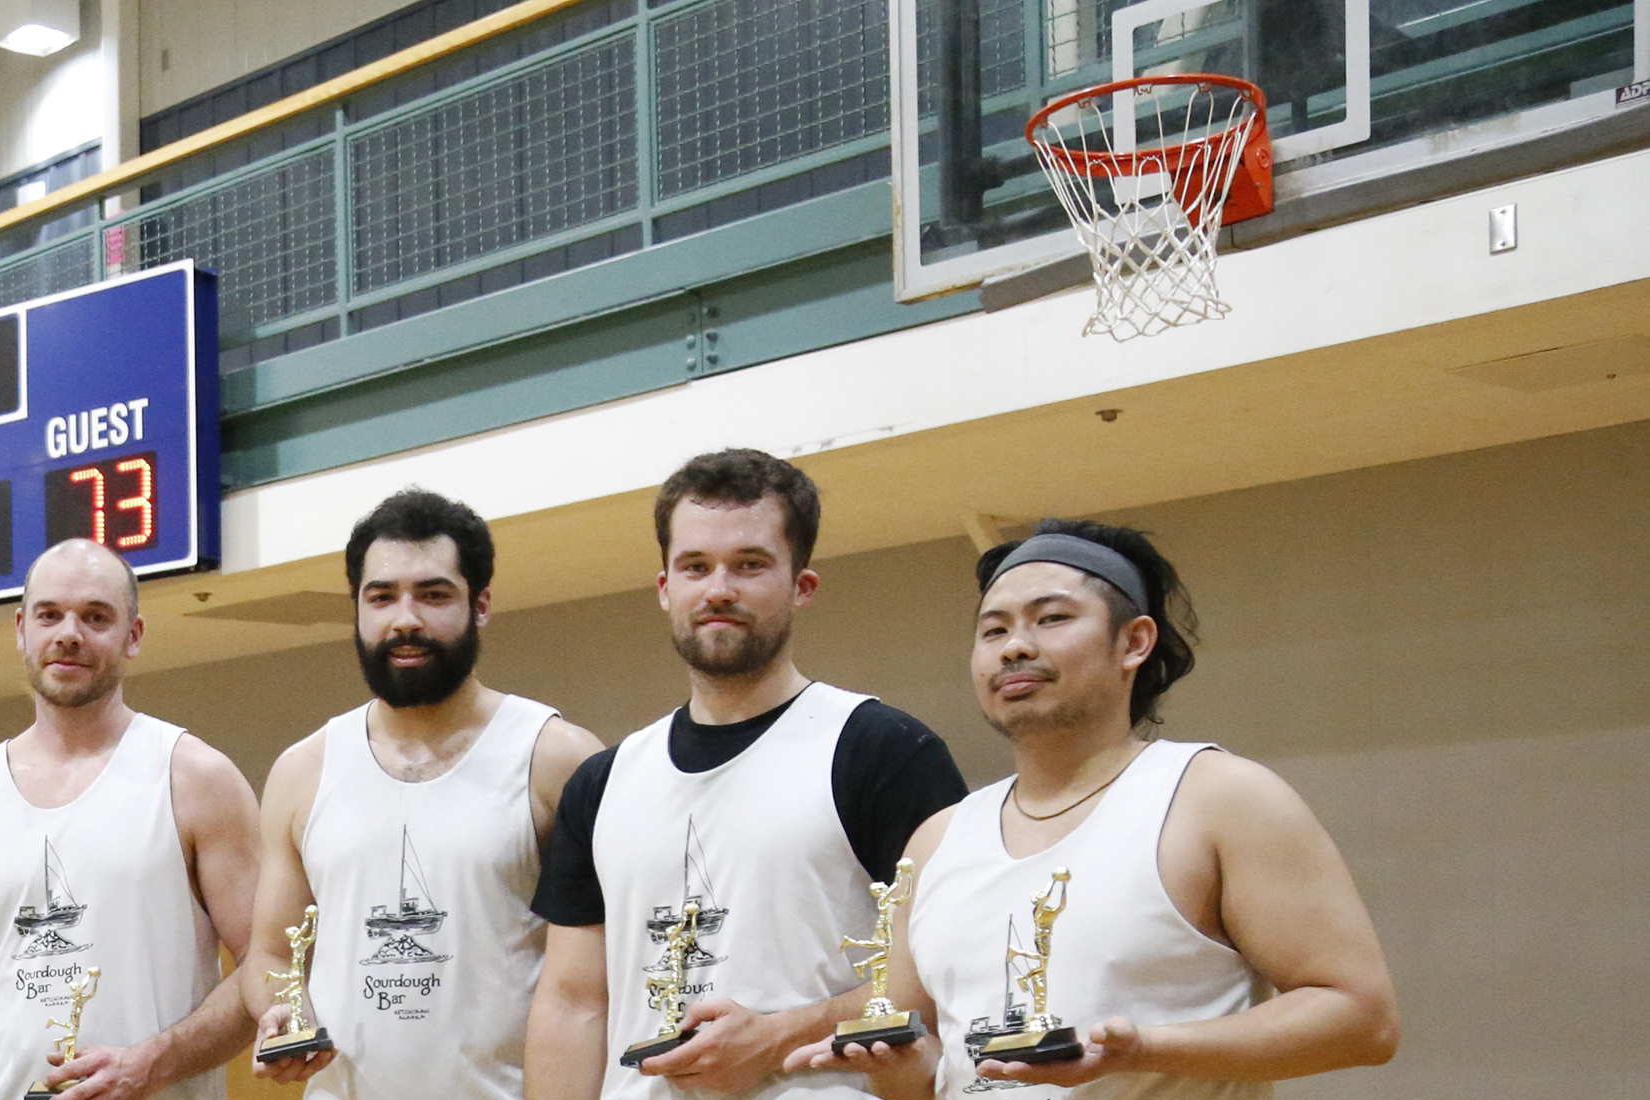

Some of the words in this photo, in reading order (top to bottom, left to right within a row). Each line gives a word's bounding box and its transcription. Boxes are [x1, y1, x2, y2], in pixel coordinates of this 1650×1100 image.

[46, 398, 149, 458] GUEST
[69, 458, 152, 547] 73
[16, 962, 82, 991] Sourdough
[363, 973, 441, 999] Sourdough
[26, 983, 51, 1000] Bar
[377, 991, 406, 1010] Bar
